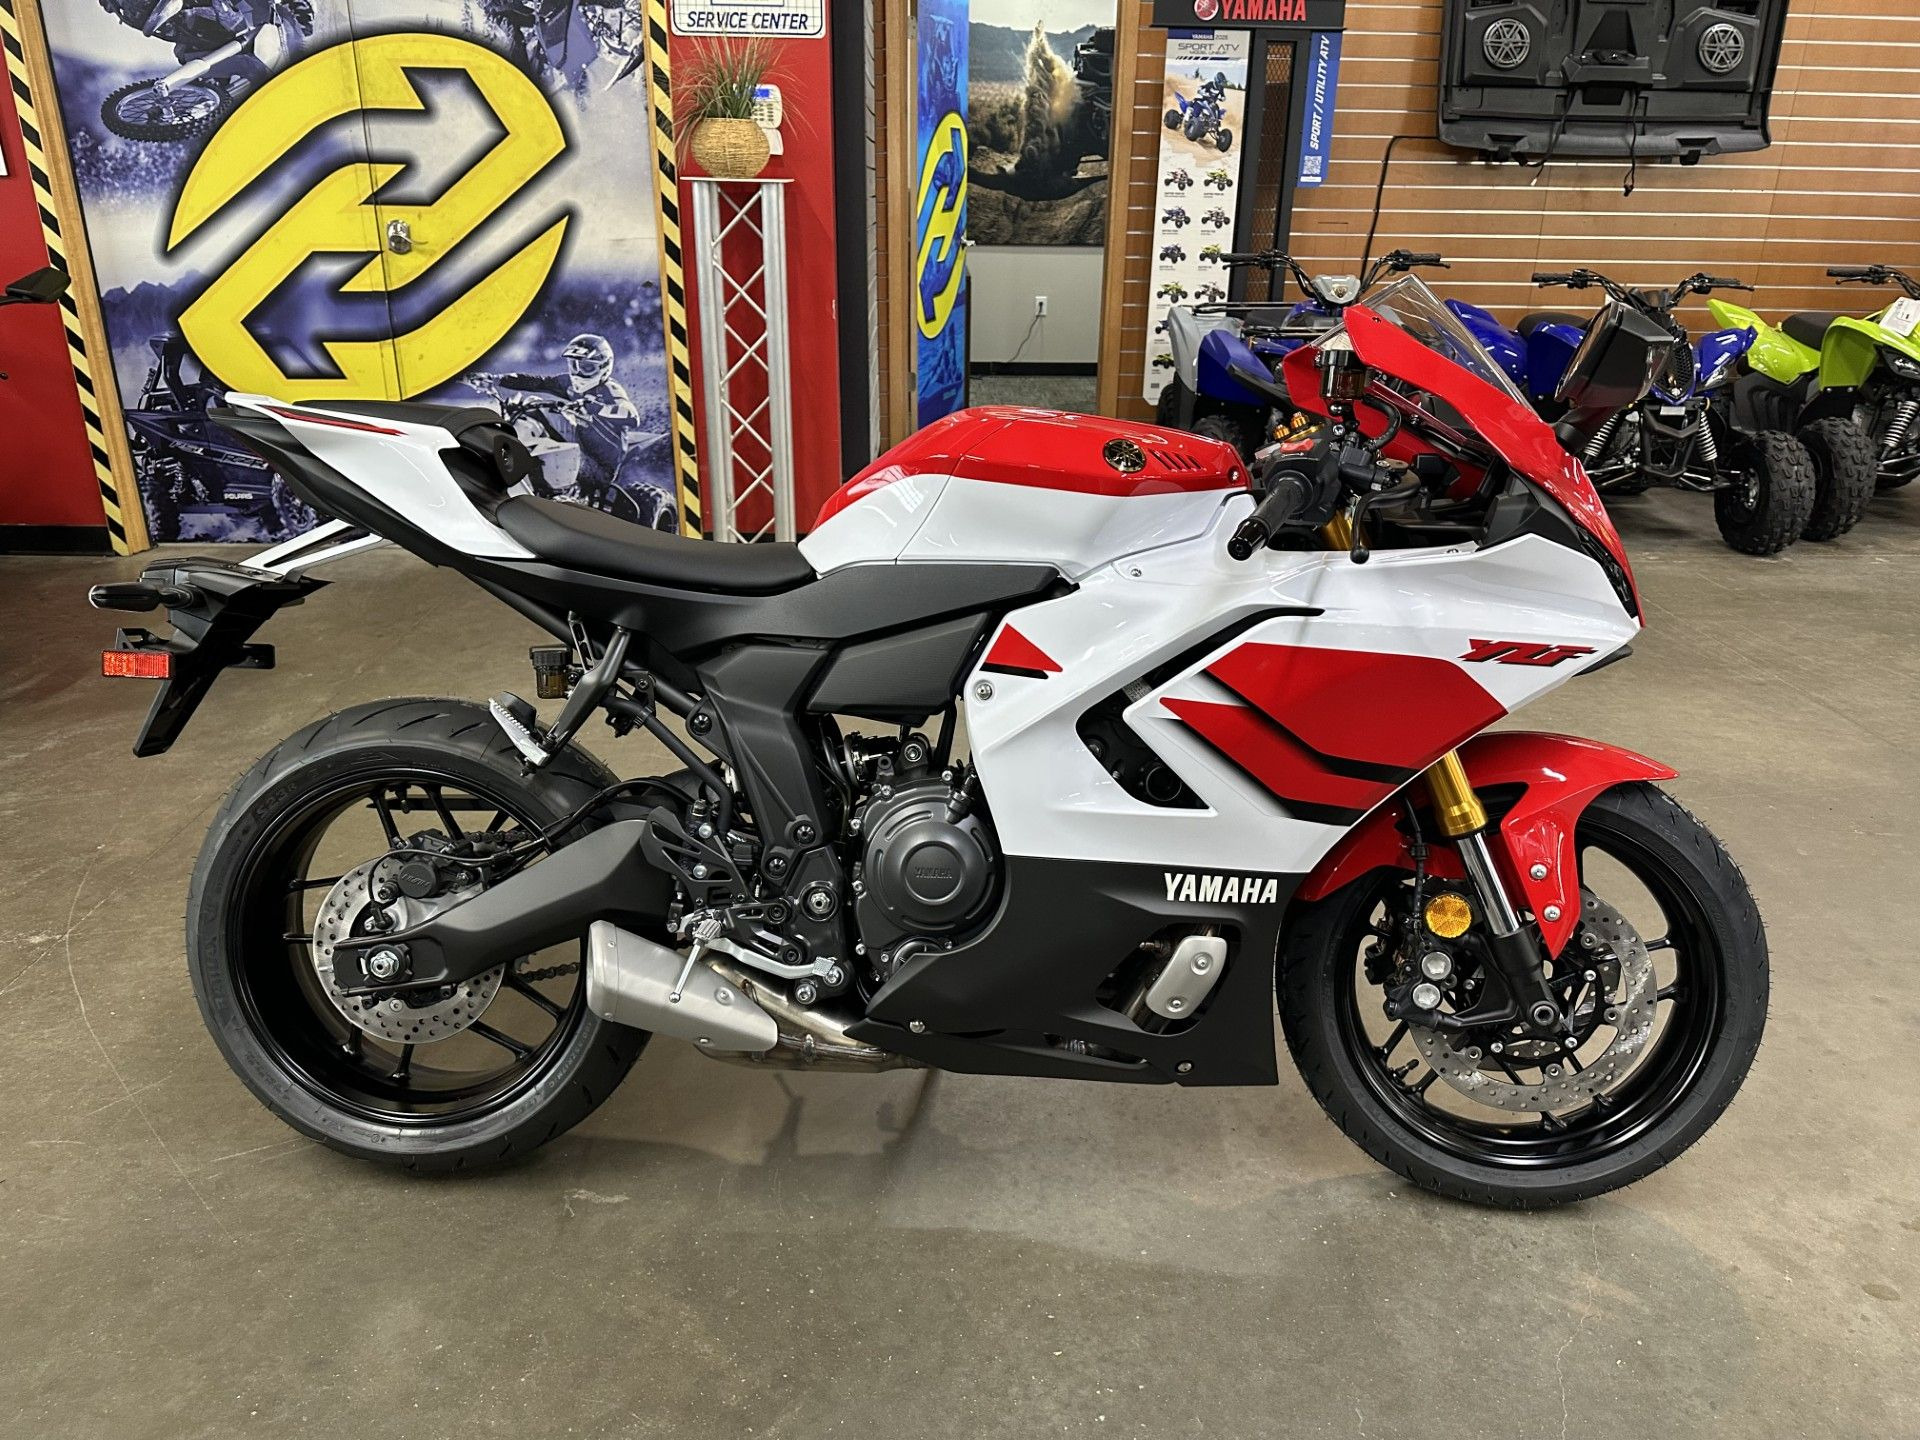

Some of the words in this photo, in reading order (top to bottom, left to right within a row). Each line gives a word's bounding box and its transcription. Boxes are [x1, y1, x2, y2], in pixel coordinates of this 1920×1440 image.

[687, 11, 747, 28] SERVICE
[752, 12, 808, 30] CENTER
[1221, 0, 1307, 21] YAMAHA
[1178, 43, 1214, 51] SPORT
[1319, 35, 1330, 60] ATV
[1313, 58, 1328, 104] UTILITY
[1309, 111, 1323, 150] SPORT
[1456, 638, 1599, 667] YZF
[914, 864, 953, 879] YAMAHA
[1164, 872, 1278, 904] YAMAHA
